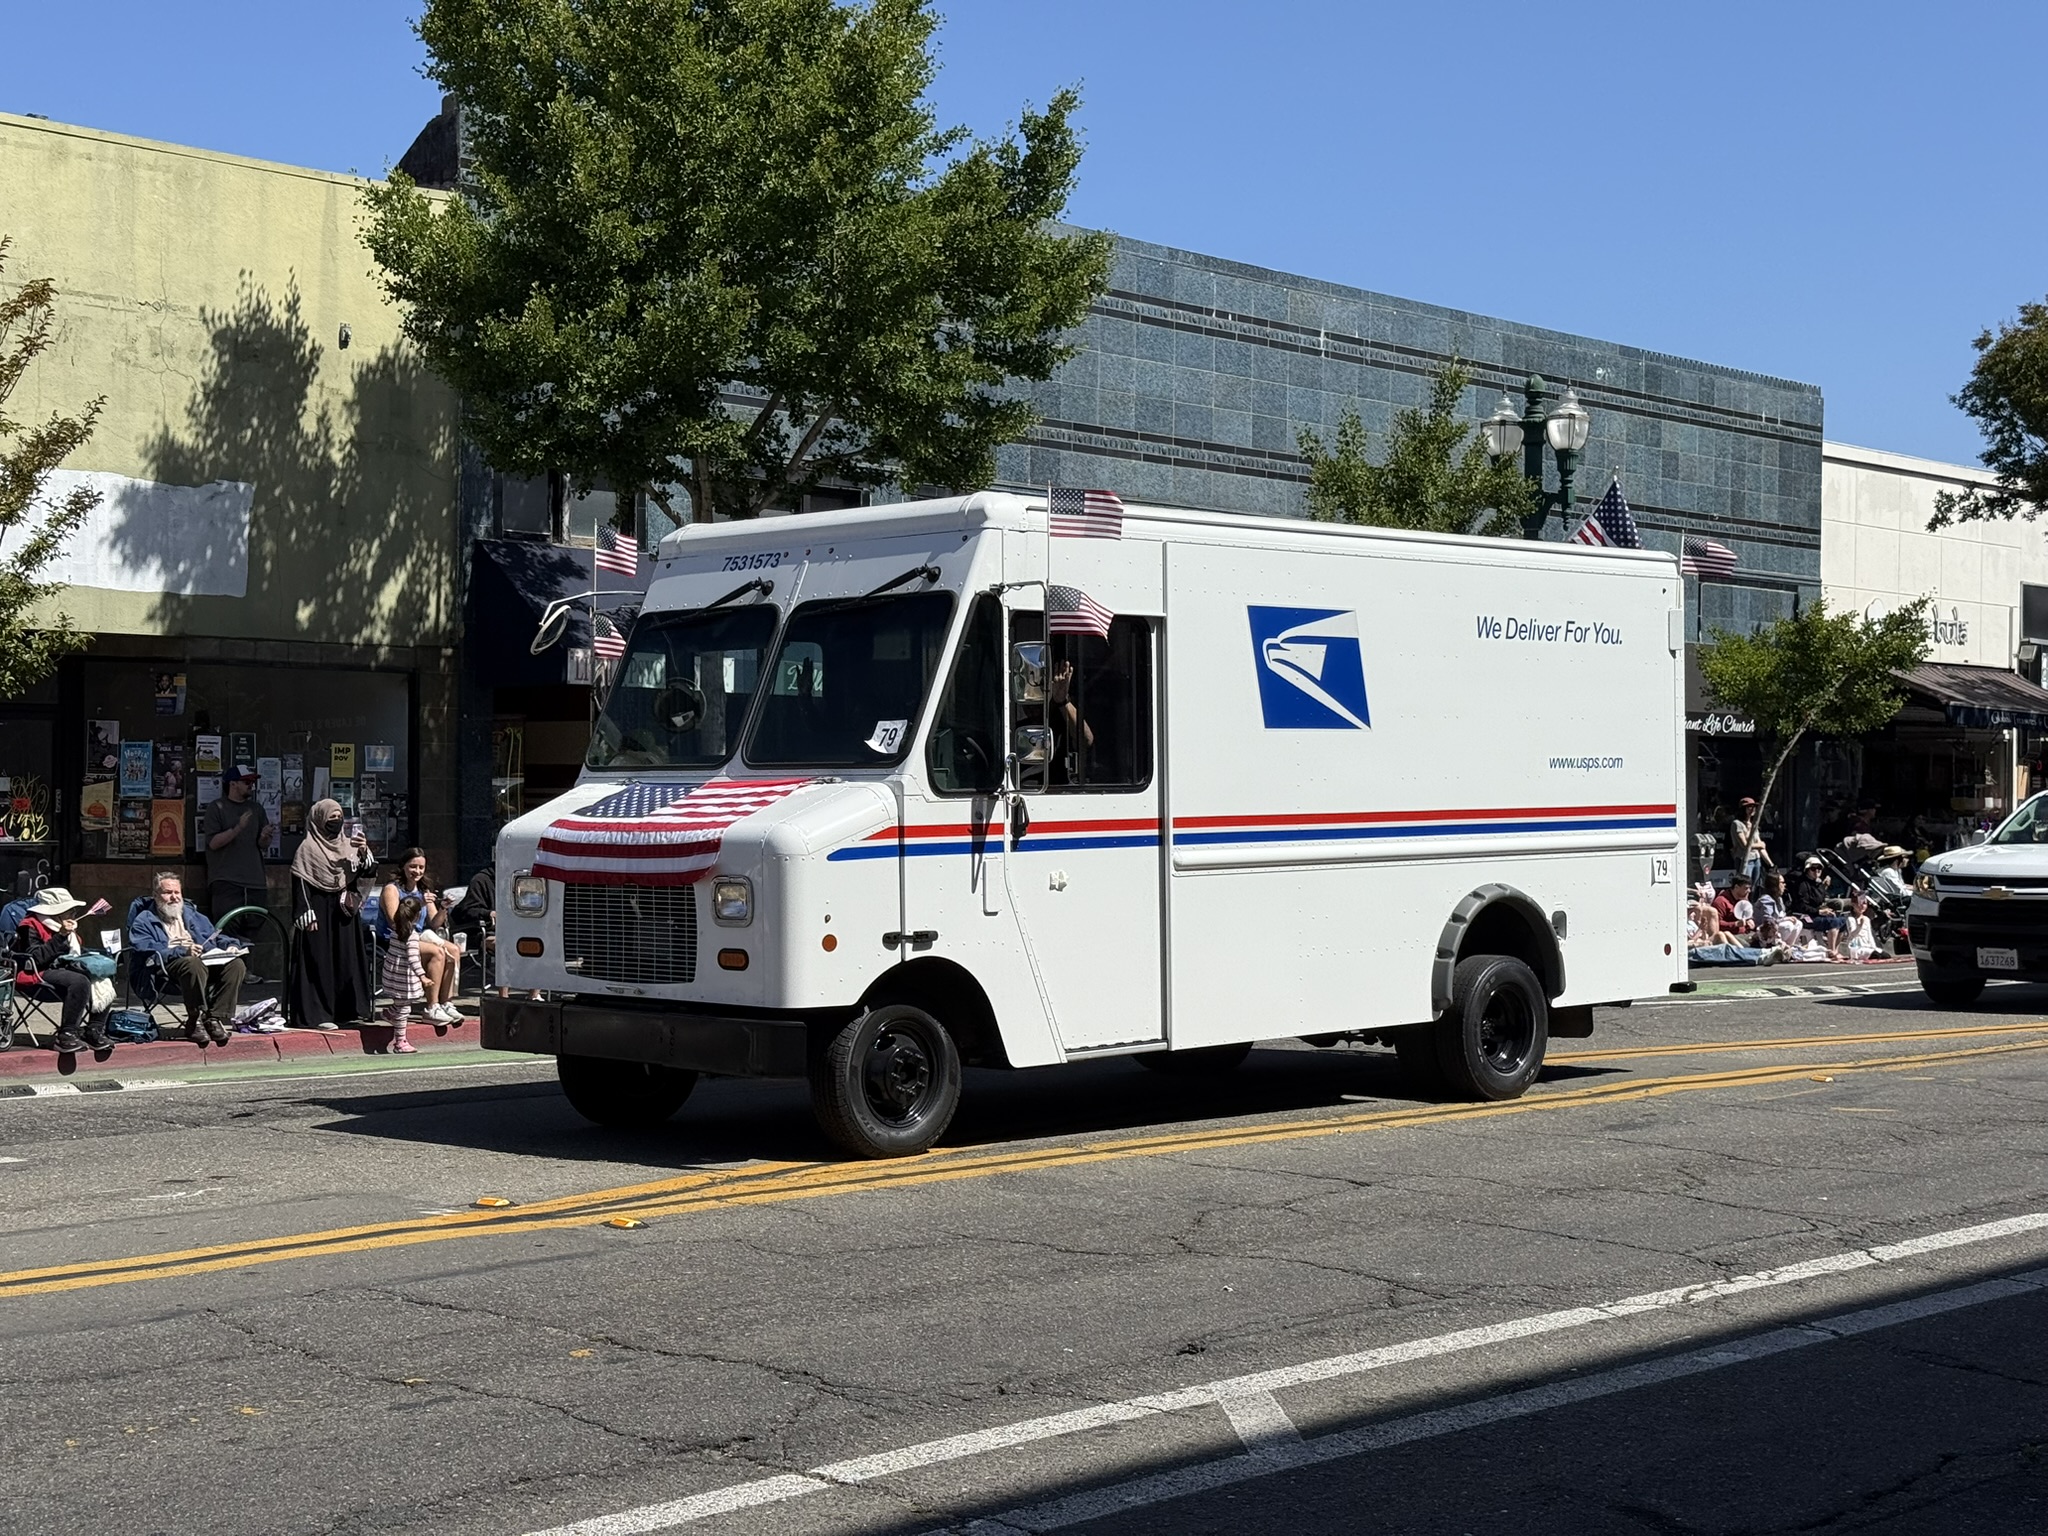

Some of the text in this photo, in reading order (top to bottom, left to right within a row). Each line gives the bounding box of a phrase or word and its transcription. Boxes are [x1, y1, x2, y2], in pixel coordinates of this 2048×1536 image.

[722, 552, 782, 572] 7531573
[1476, 615, 1623, 645] We Deliver For You.
[1702, 713, 1722, 736] Life
[1722, 714, 1756, 733] Church
[878, 727, 898, 747] 79
[334, 746, 351, 754] IMP
[1549, 757, 1624, 772] www.usps.com
[1656, 859, 1668, 877] 79
